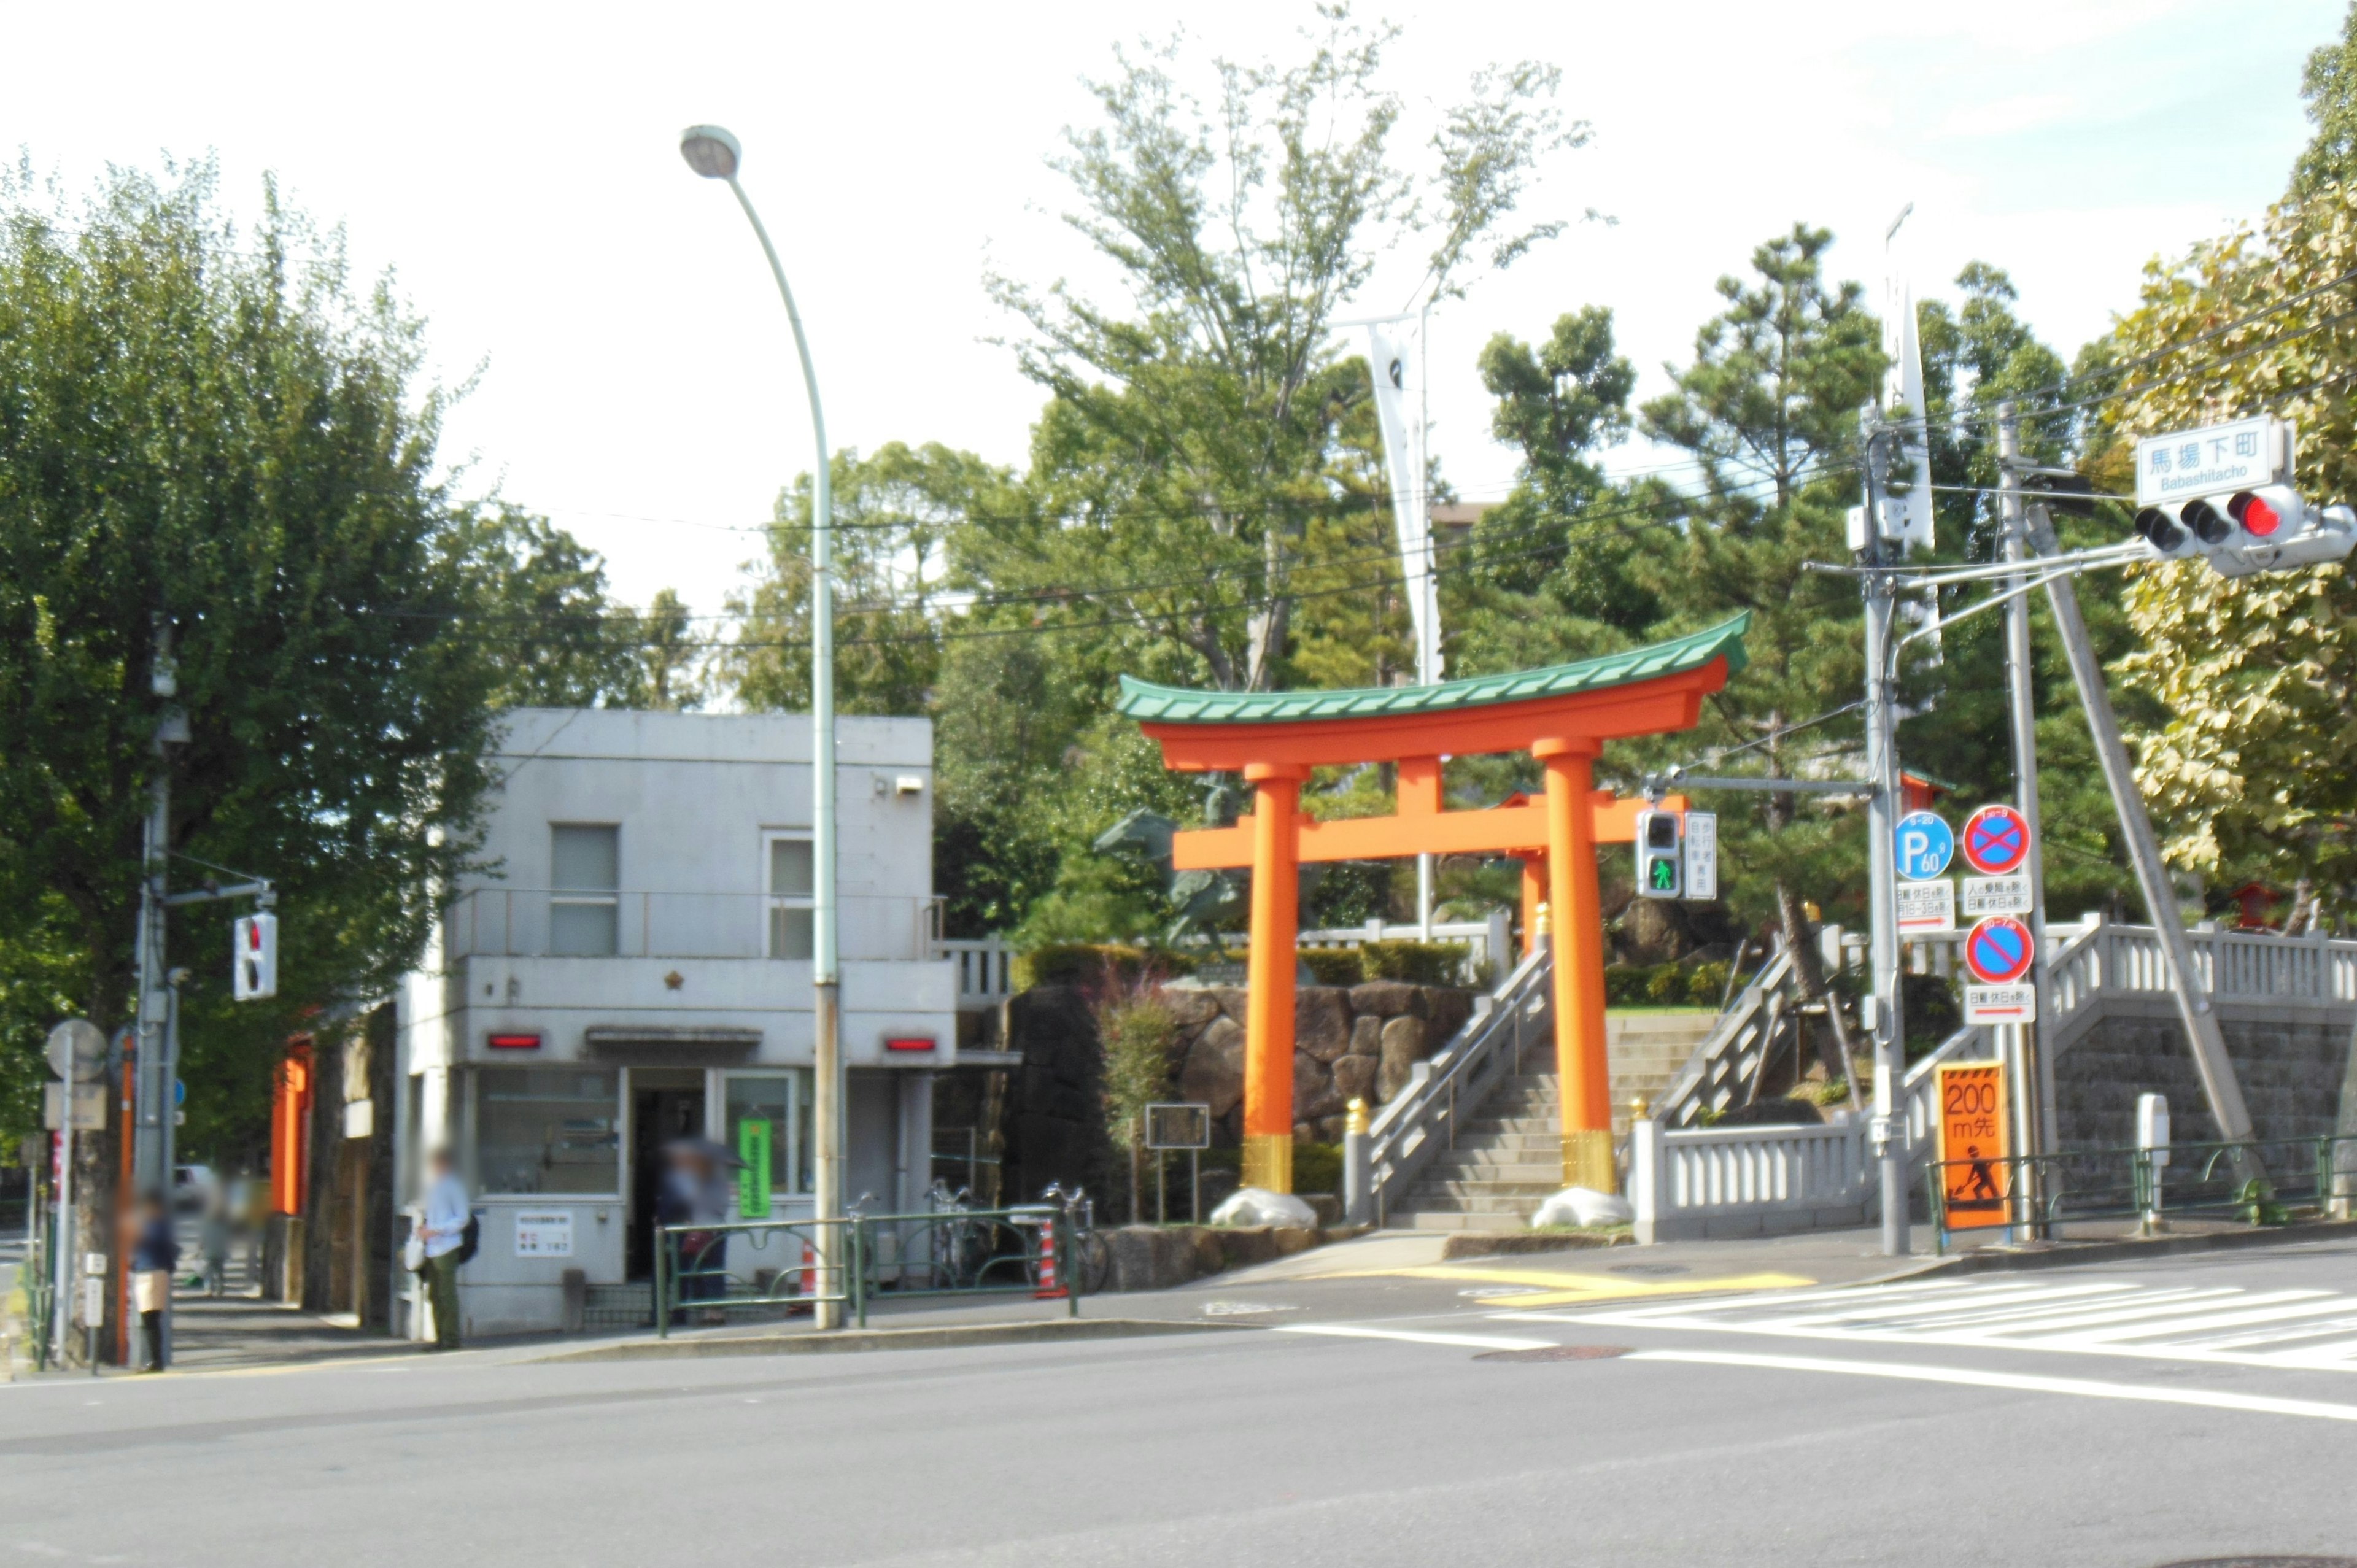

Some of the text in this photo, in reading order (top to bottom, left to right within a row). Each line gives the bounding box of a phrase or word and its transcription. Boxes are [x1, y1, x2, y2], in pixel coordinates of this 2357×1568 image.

[2150, 431, 2259, 475] 馬場下町
[2161, 465, 2248, 491] Babashitacho
[1905, 832, 1929, 873] P
[1946, 1084, 1995, 1114] 200
